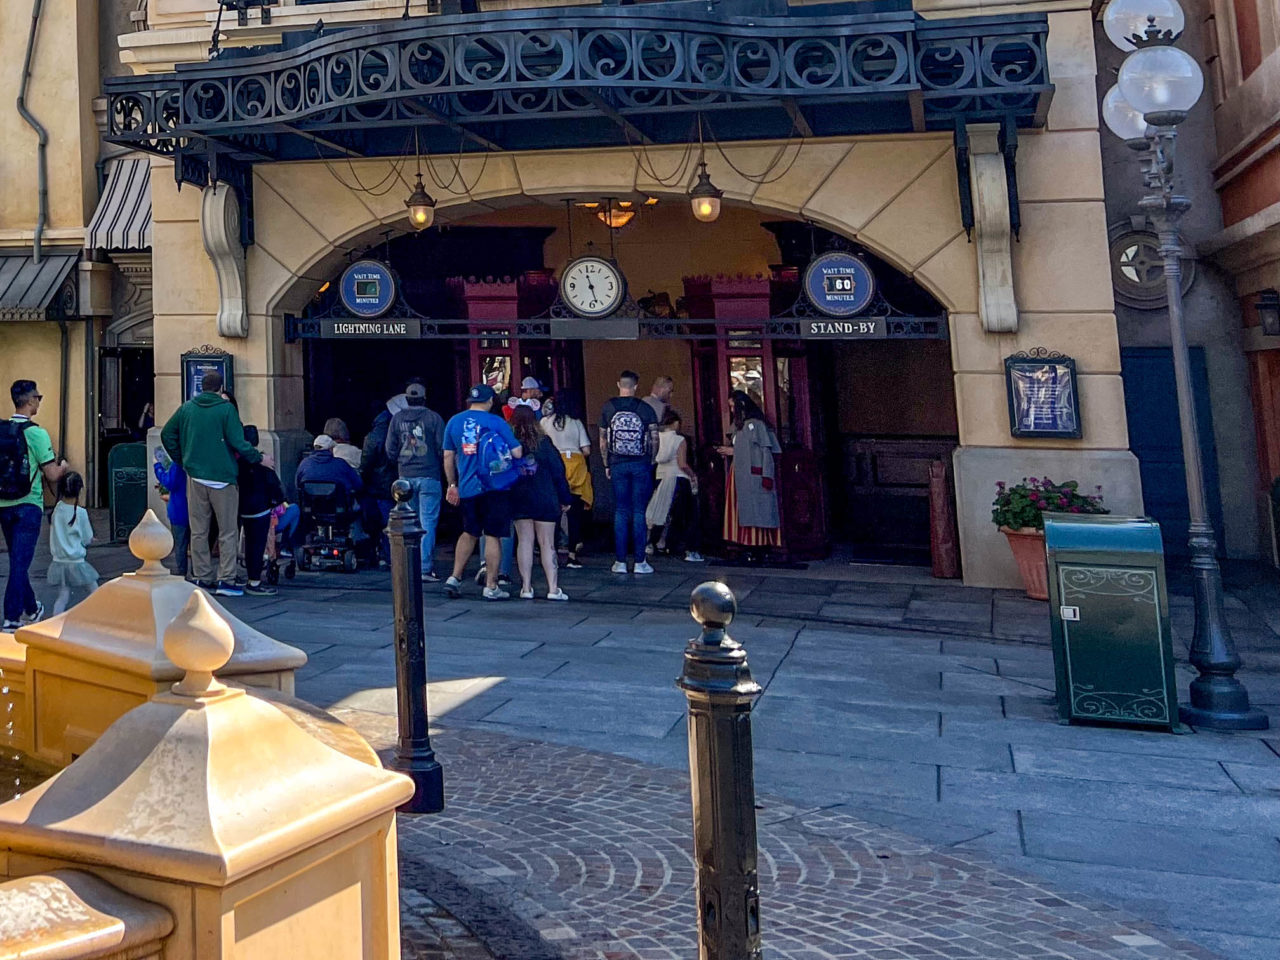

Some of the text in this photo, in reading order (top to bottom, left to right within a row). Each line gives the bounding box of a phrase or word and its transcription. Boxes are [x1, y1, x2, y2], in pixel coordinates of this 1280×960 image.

[585, 265, 595, 274] 12
[569, 282, 576, 291] 9
[608, 281, 614, 291] 3
[835, 279, 851, 290] 60
[589, 300, 596, 309] 6
[334, 323, 407, 334] LIGHTNING LANE
[810, 322, 876, 334] STAND-BY
